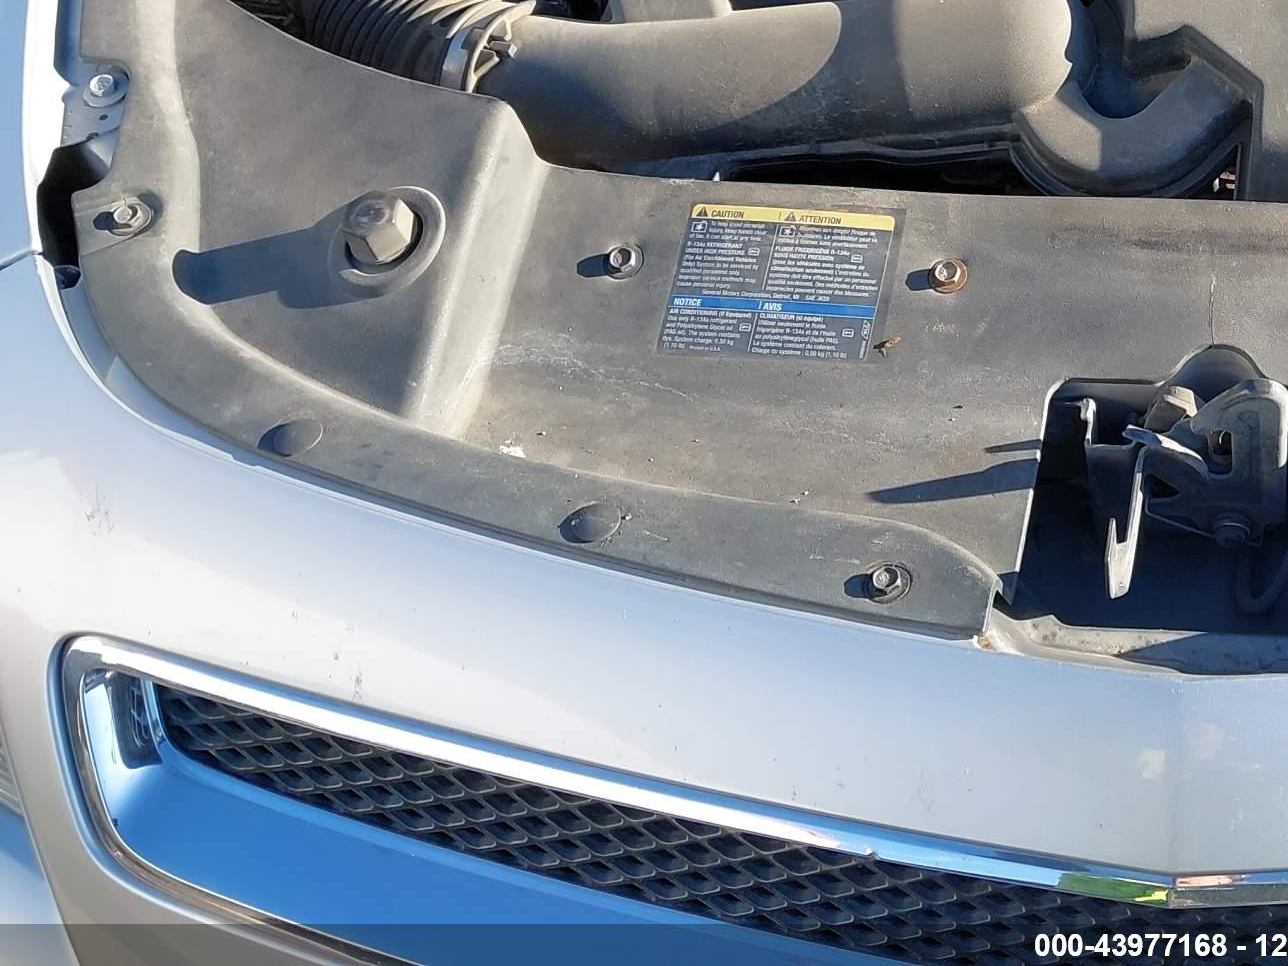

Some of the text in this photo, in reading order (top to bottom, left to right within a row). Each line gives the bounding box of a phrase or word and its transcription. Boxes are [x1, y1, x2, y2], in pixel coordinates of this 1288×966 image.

[711, 211, 745, 219] CAUTION
[799, 215, 842, 225] ATTENTION
[674, 298, 702, 306] NOTICE
[763, 303, 782, 311] AVIS
